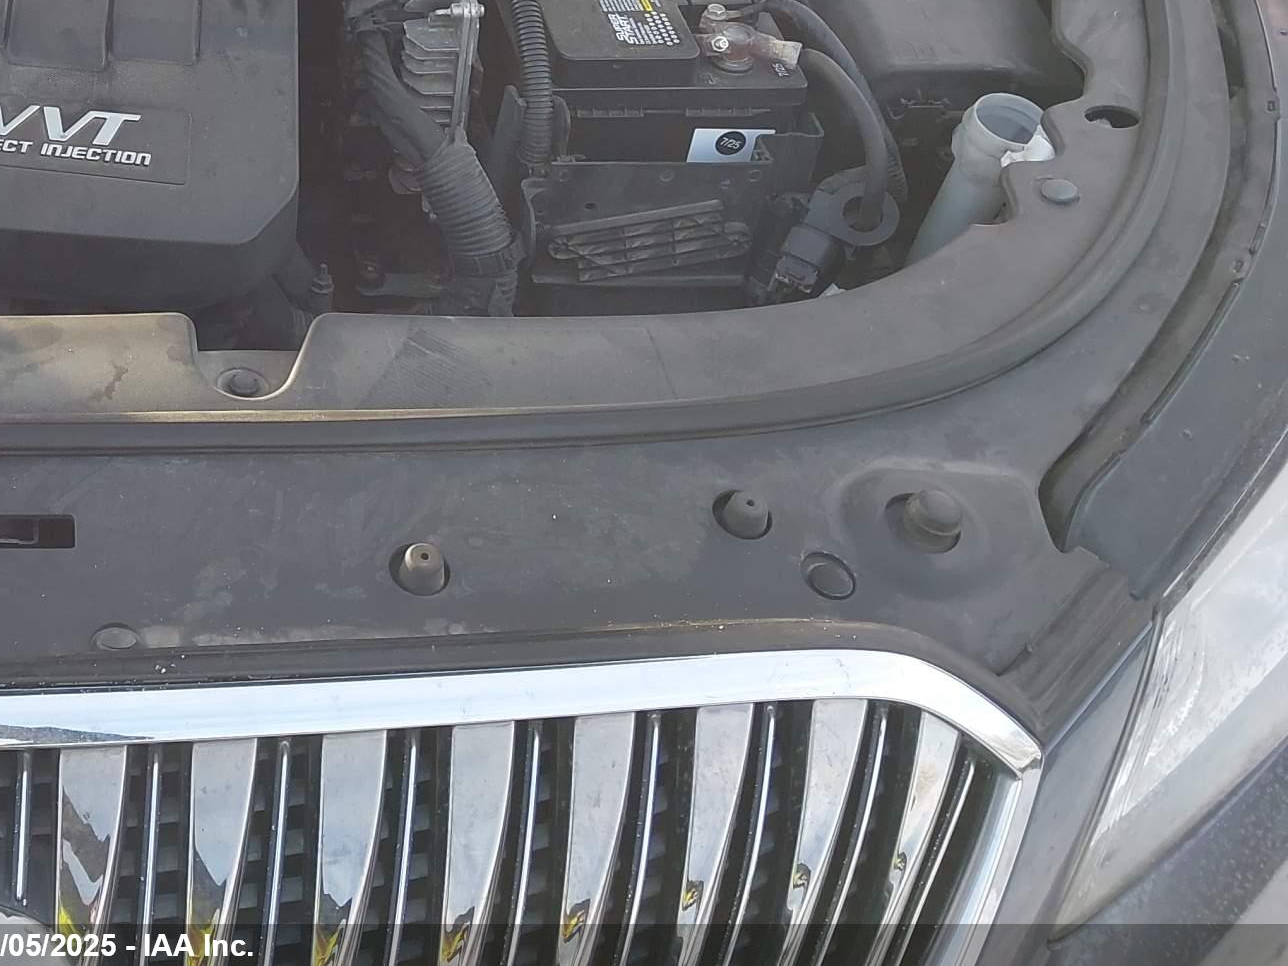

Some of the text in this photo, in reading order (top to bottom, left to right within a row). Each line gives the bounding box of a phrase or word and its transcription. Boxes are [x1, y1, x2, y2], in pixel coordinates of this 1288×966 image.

[608, 13, 625, 41] SUPER
[616, 13, 637, 45] START
[40, 143, 152, 166] INJECTION
[720, 137, 741, 149] 7/25
